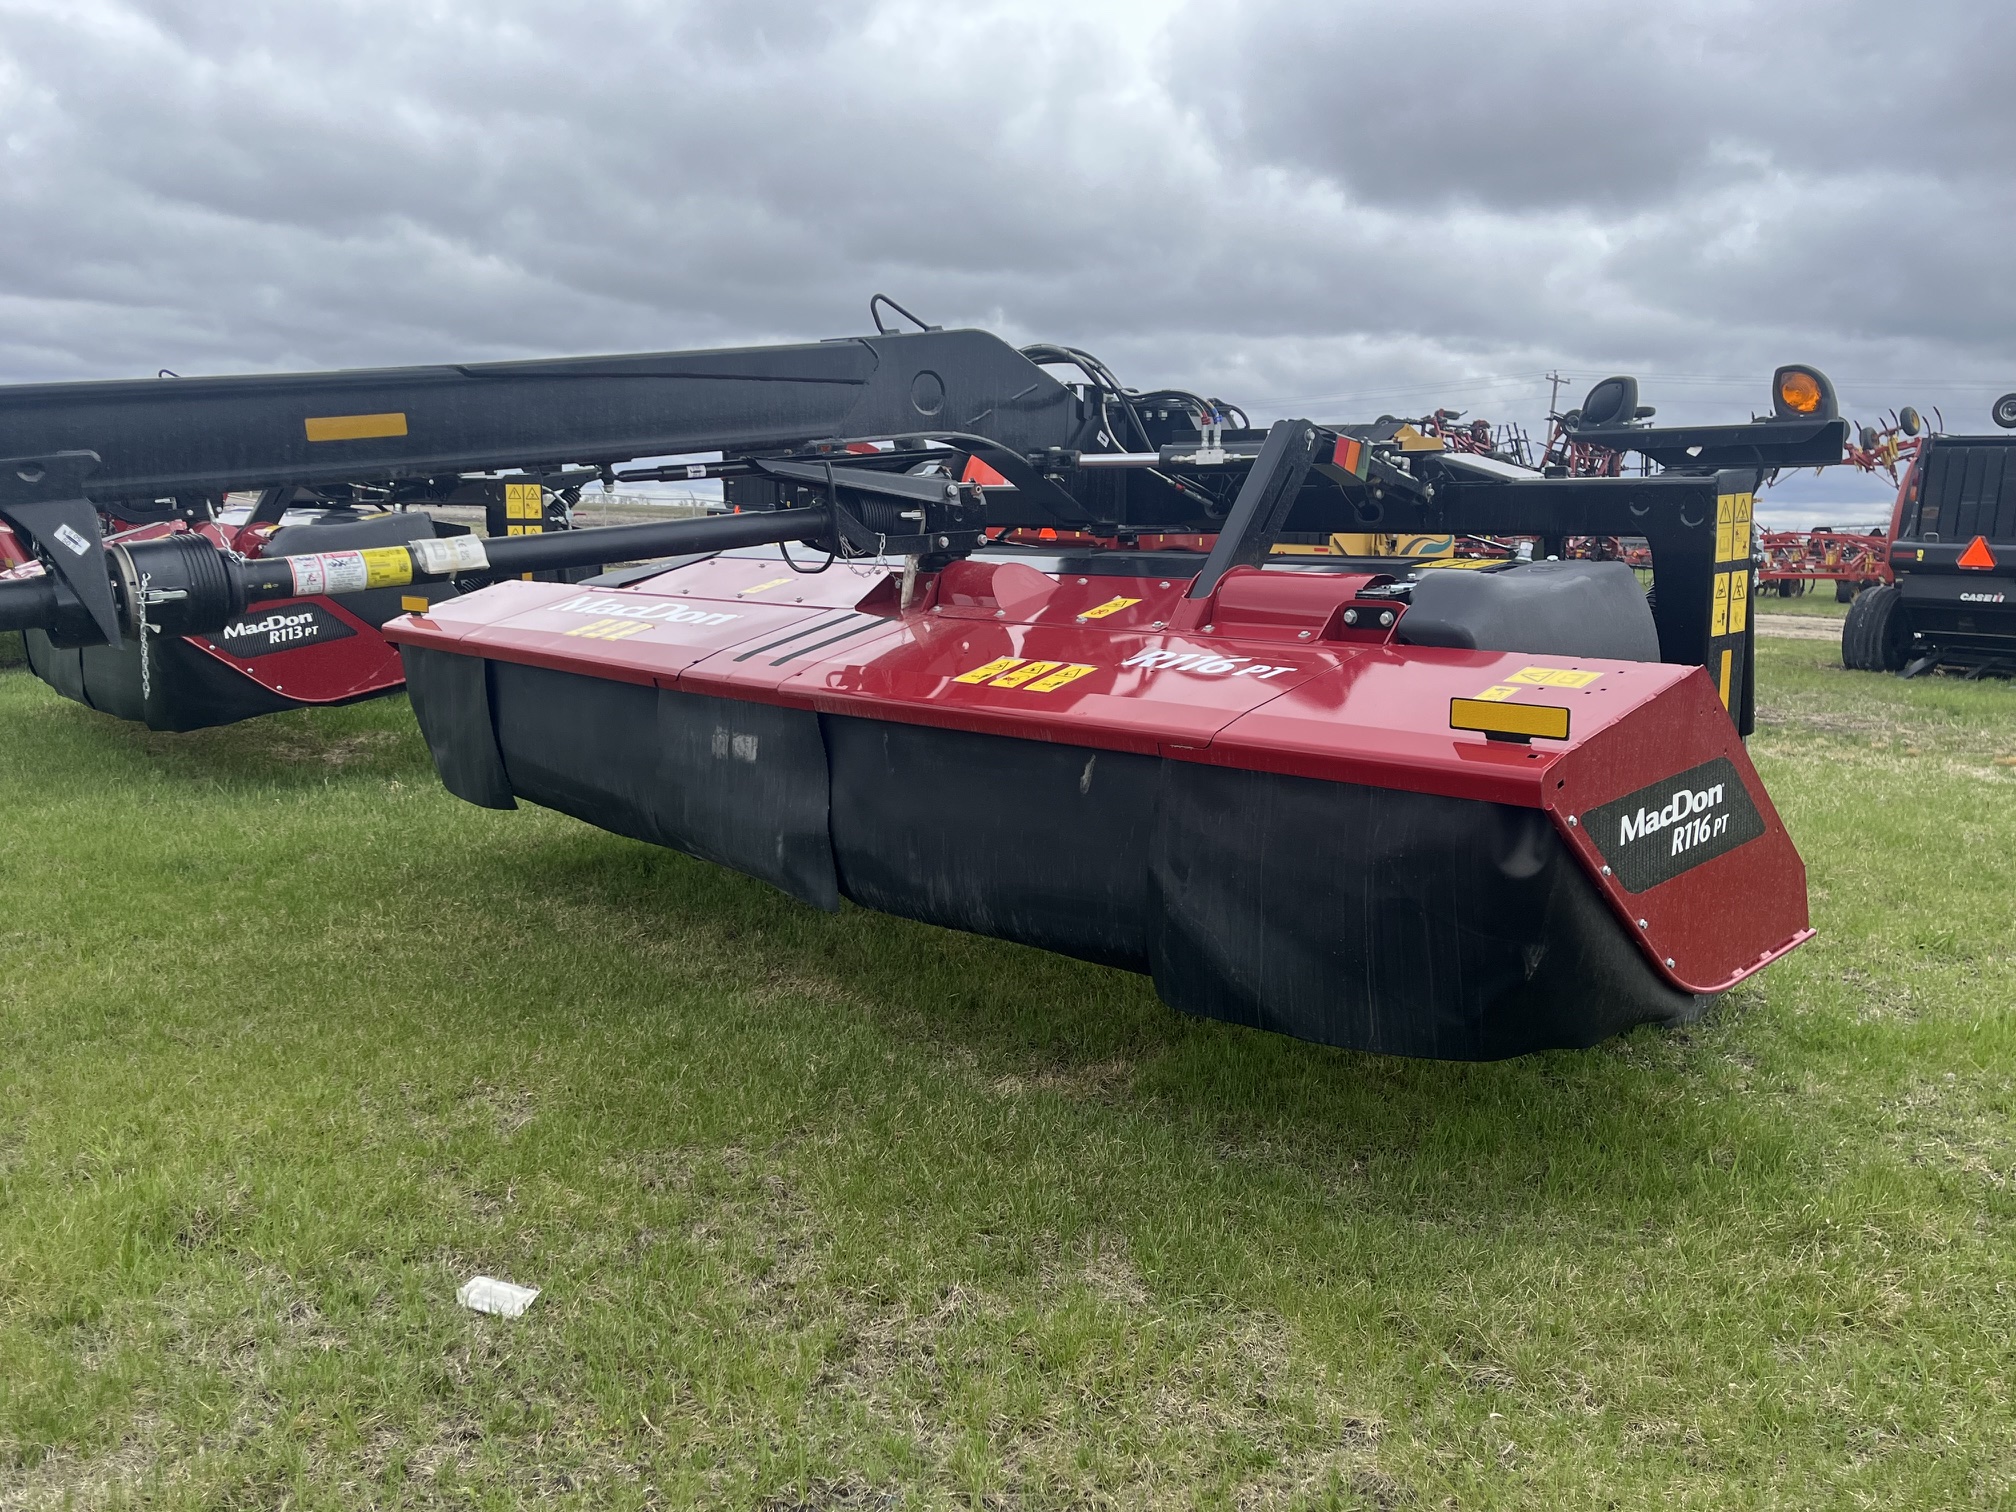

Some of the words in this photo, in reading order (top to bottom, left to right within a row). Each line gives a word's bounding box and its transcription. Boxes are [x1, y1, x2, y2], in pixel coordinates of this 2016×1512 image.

[223, 612, 313, 639] MacDon
[547, 597, 740, 626] MacDon
[269, 625, 303, 644] R113
[304, 625, 319, 637] PT
[1121, 650, 1252, 674] R116
[1230, 664, 1298, 679] PT
[1619, 783, 1724, 847] MacDon
[1671, 813, 1711, 856] R116
[1712, 813, 1730, 838] PT
